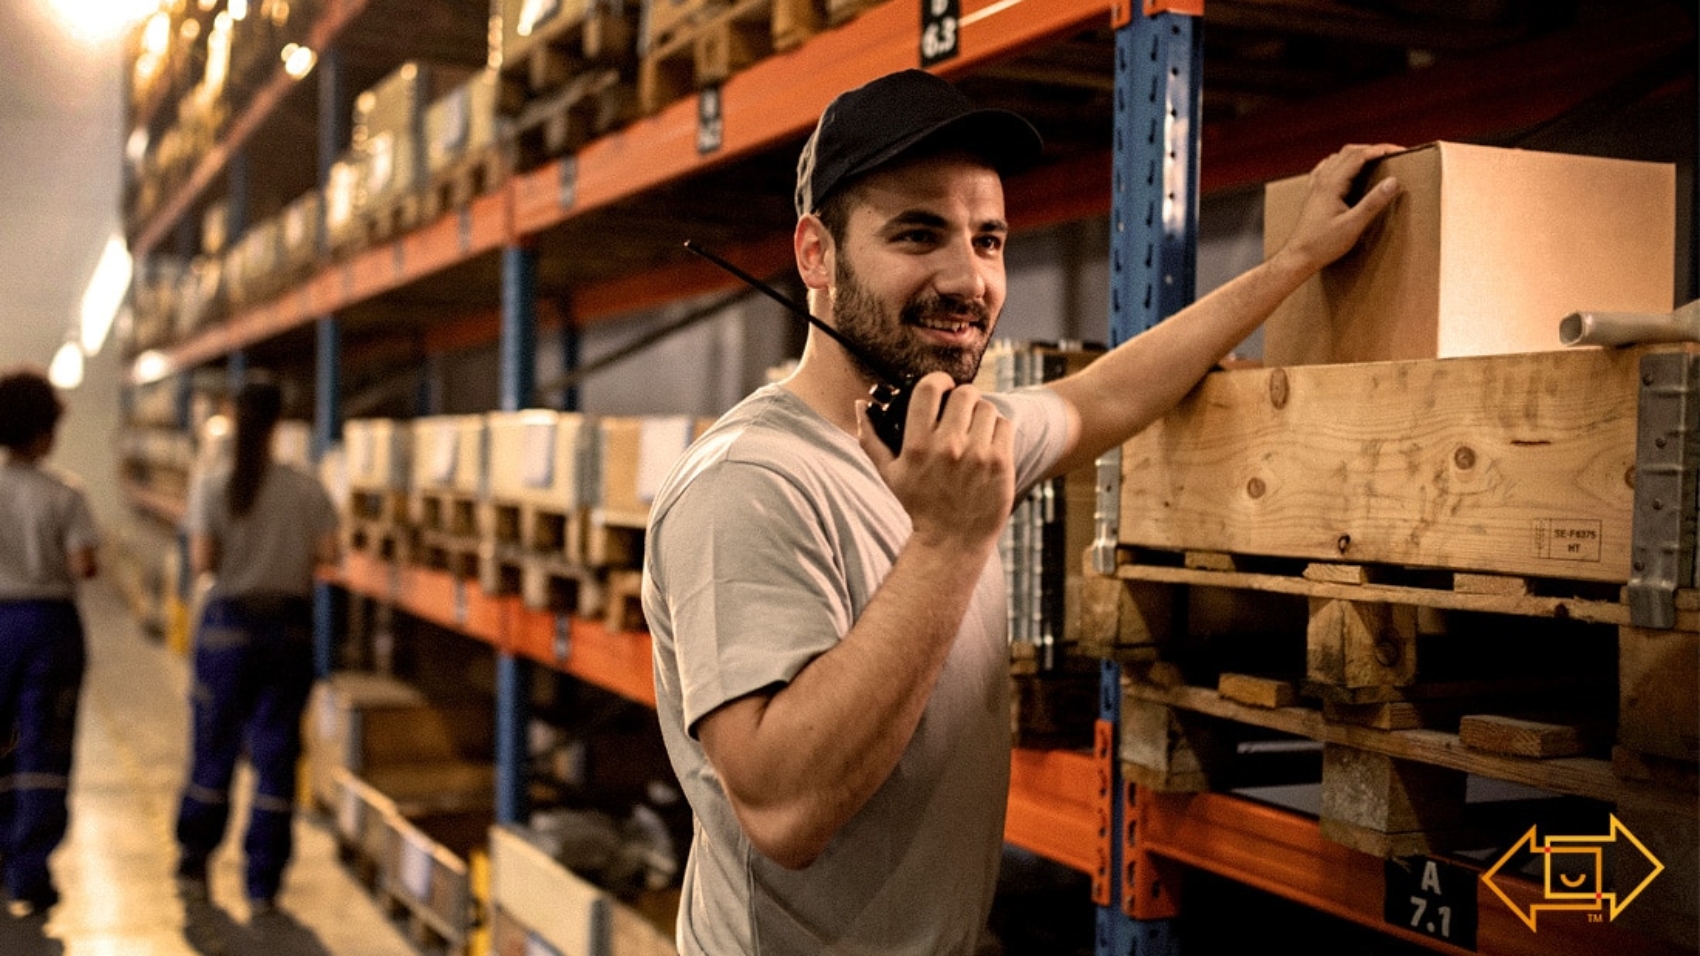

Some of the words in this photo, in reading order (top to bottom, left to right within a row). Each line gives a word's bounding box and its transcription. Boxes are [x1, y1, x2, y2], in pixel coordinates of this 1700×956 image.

[922, 17, 956, 58] 6.3
[1568, 544, 1581, 553] HT
[1421, 860, 1443, 896] A
[1410, 895, 1452, 938] 7.1
